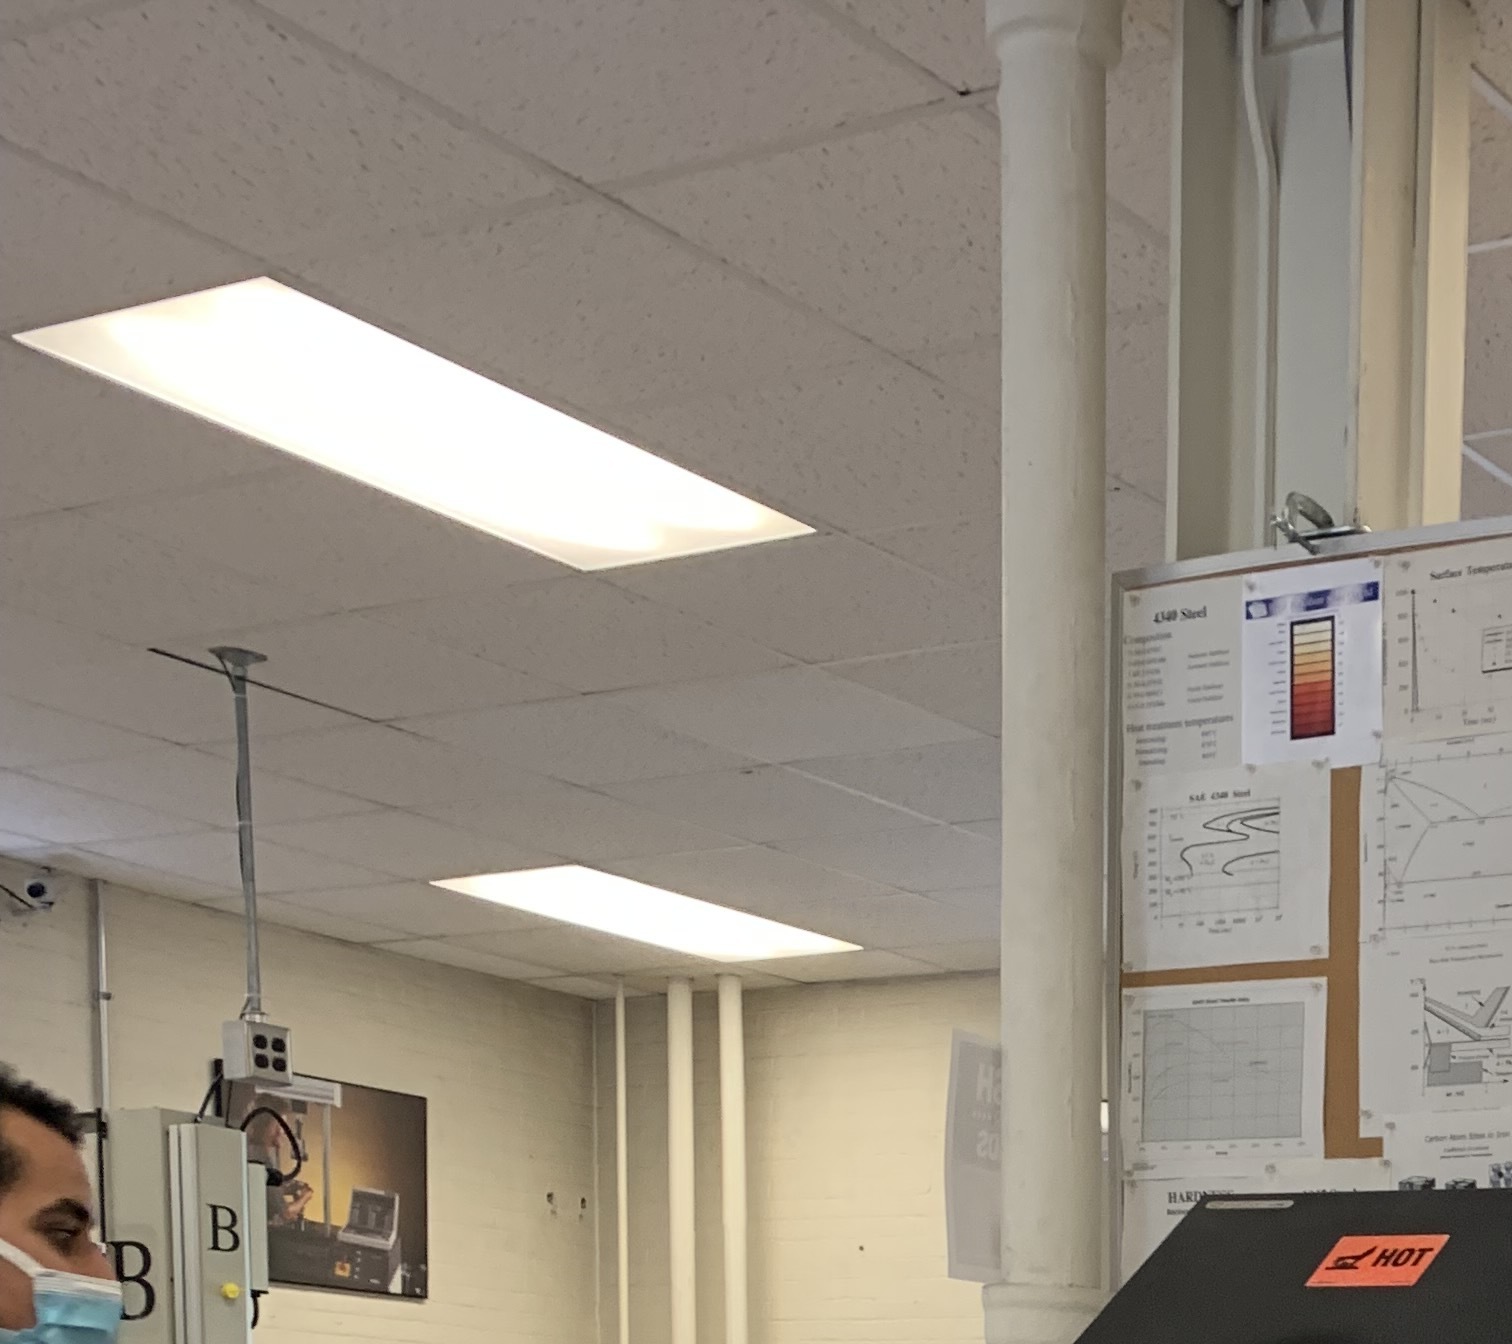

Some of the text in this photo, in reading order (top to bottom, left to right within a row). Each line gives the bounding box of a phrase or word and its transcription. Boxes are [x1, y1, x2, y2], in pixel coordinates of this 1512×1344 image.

[1430, 570, 1462, 580] Surface
[1153, 609, 1178, 623] 4340
[206, 1203, 240, 1252] B
[1372, 1248, 1435, 1267] HOT
[106, 1240, 156, 1321] B
